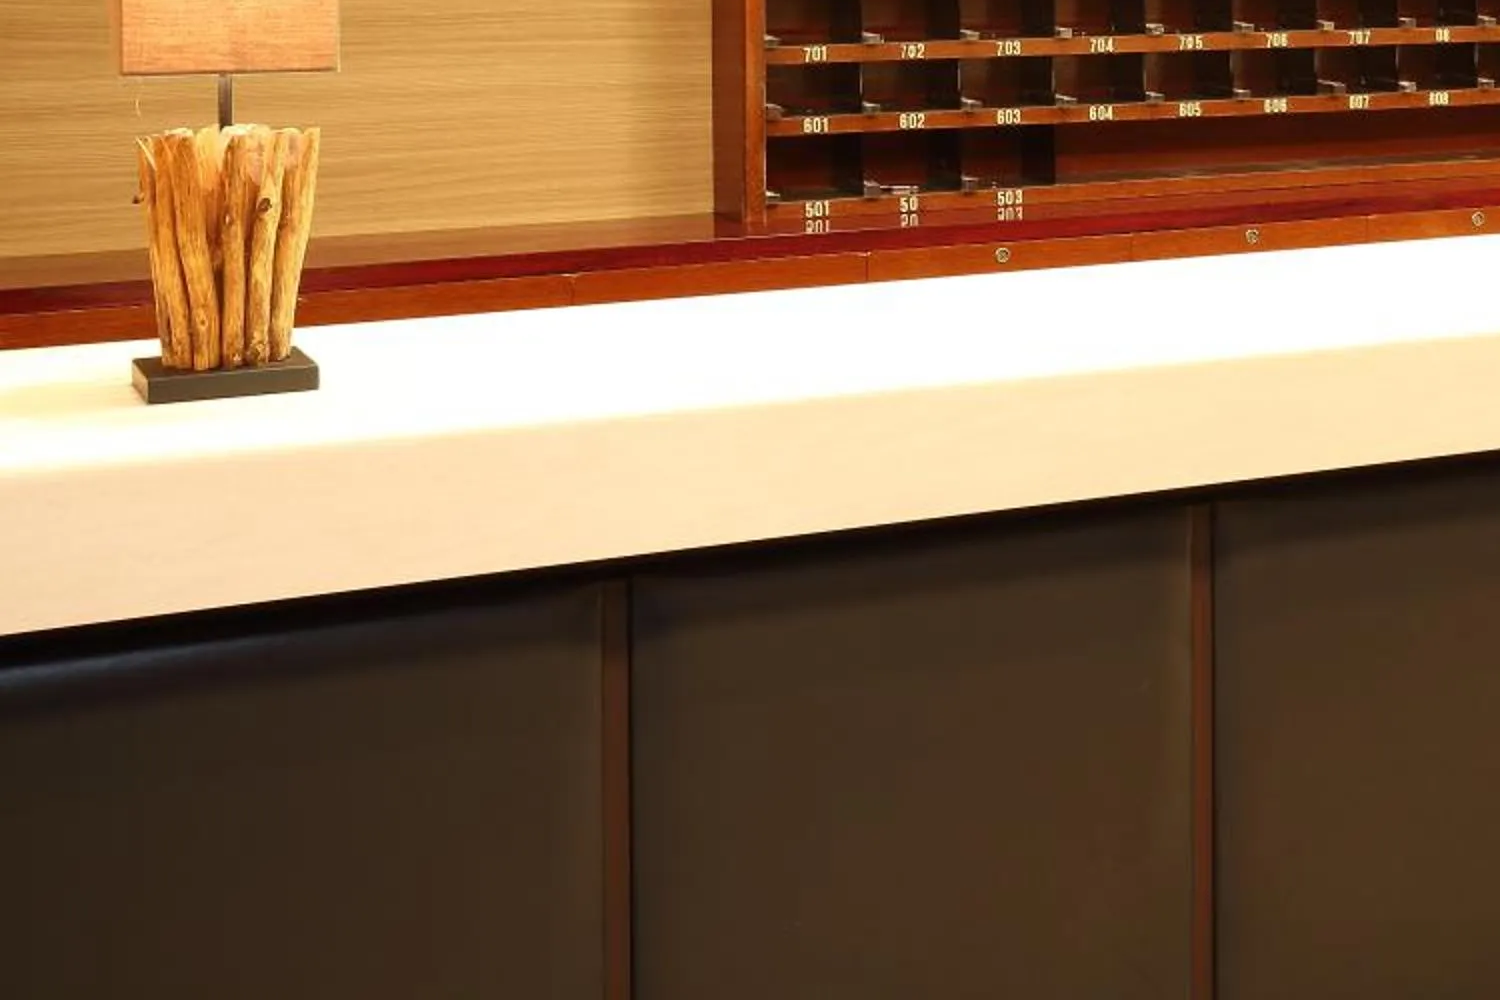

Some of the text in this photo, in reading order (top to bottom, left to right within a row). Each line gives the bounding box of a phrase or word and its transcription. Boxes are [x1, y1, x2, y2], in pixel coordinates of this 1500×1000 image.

[1090, 37, 1115, 53] 704
[1178, 35, 1203, 51] 705
[1265, 33, 1288, 48] 706
[1348, 30, 1371, 45] 707
[803, 46, 827, 62] 701
[900, 42, 925, 59] 702
[996, 40, 1021, 56] 703
[1179, 101, 1202, 117] 605
[1264, 98, 1287, 113] 606
[1349, 95, 1370, 109] 607
[899, 112, 925, 129] 602
[996, 108, 1021, 125] 603
[1089, 105, 1113, 121] 604
[803, 116, 829, 133] 601
[899, 197, 918, 212] 50
[997, 189, 1023, 205] 503
[805, 201, 830, 217] 501
